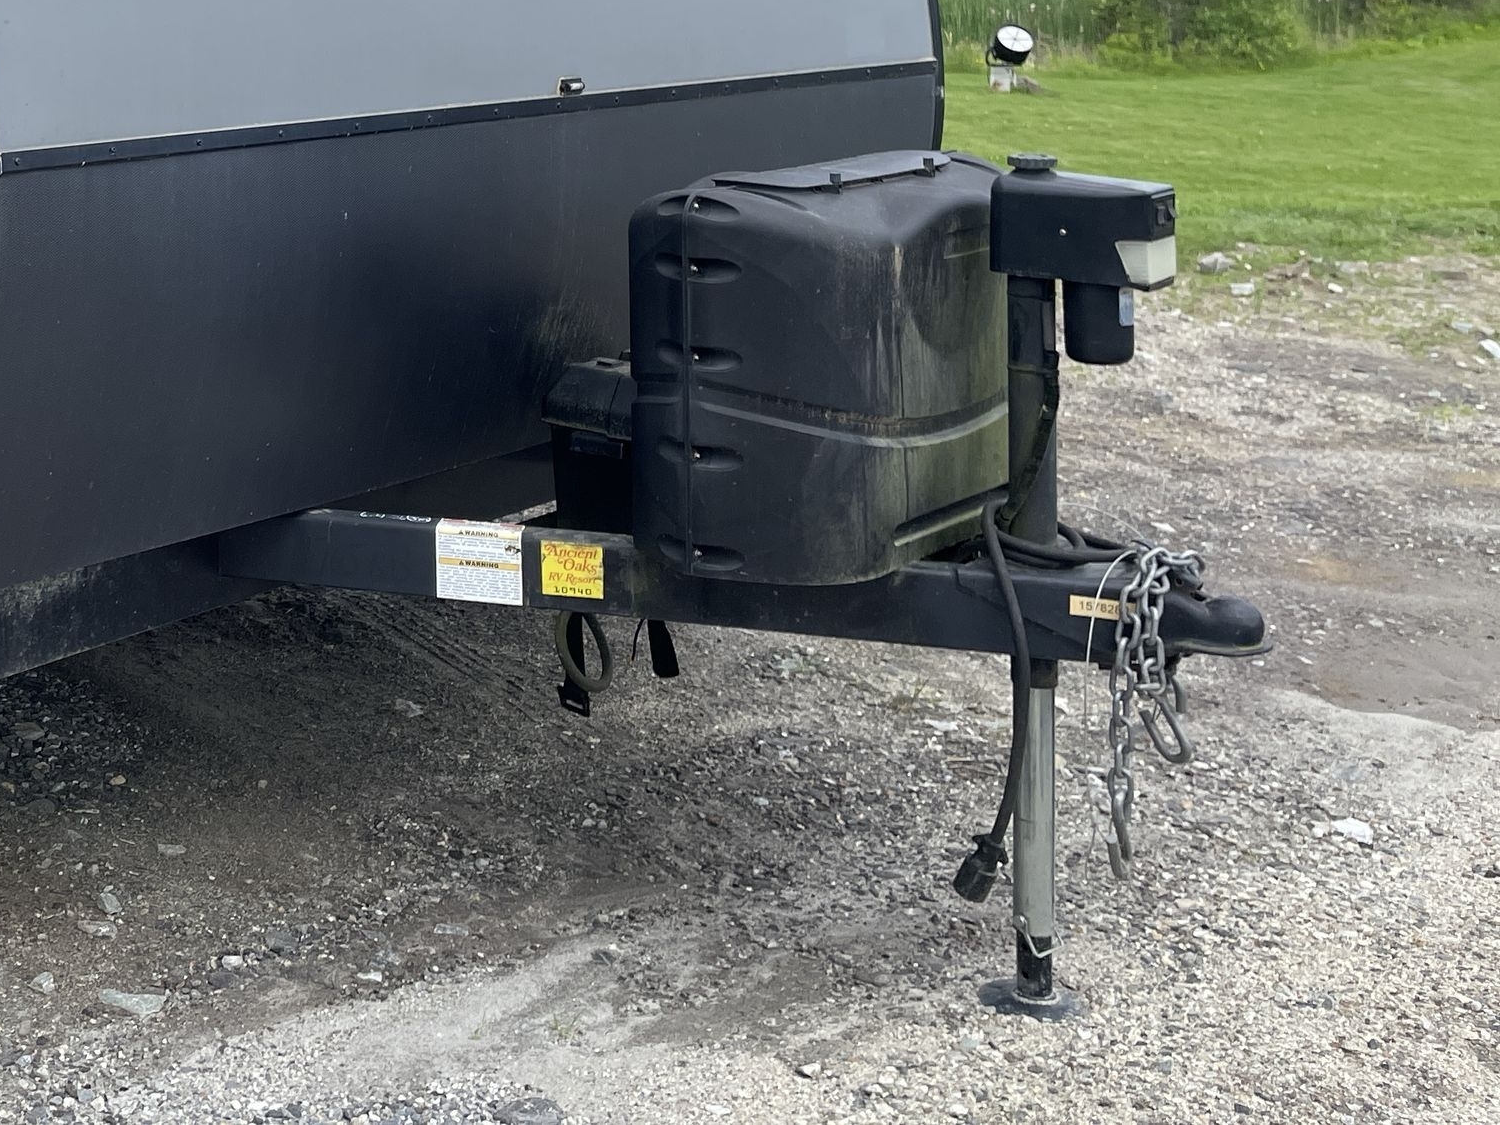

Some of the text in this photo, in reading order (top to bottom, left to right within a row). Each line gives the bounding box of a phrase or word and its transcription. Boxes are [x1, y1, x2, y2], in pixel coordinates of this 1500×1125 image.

[464, 529, 499, 538] WARNING
[544, 544, 598, 560] Ancient
[464, 559, 499, 569] WARNING
[557, 557, 598, 576] Oaks
[548, 571, 600, 585] RV Resort
